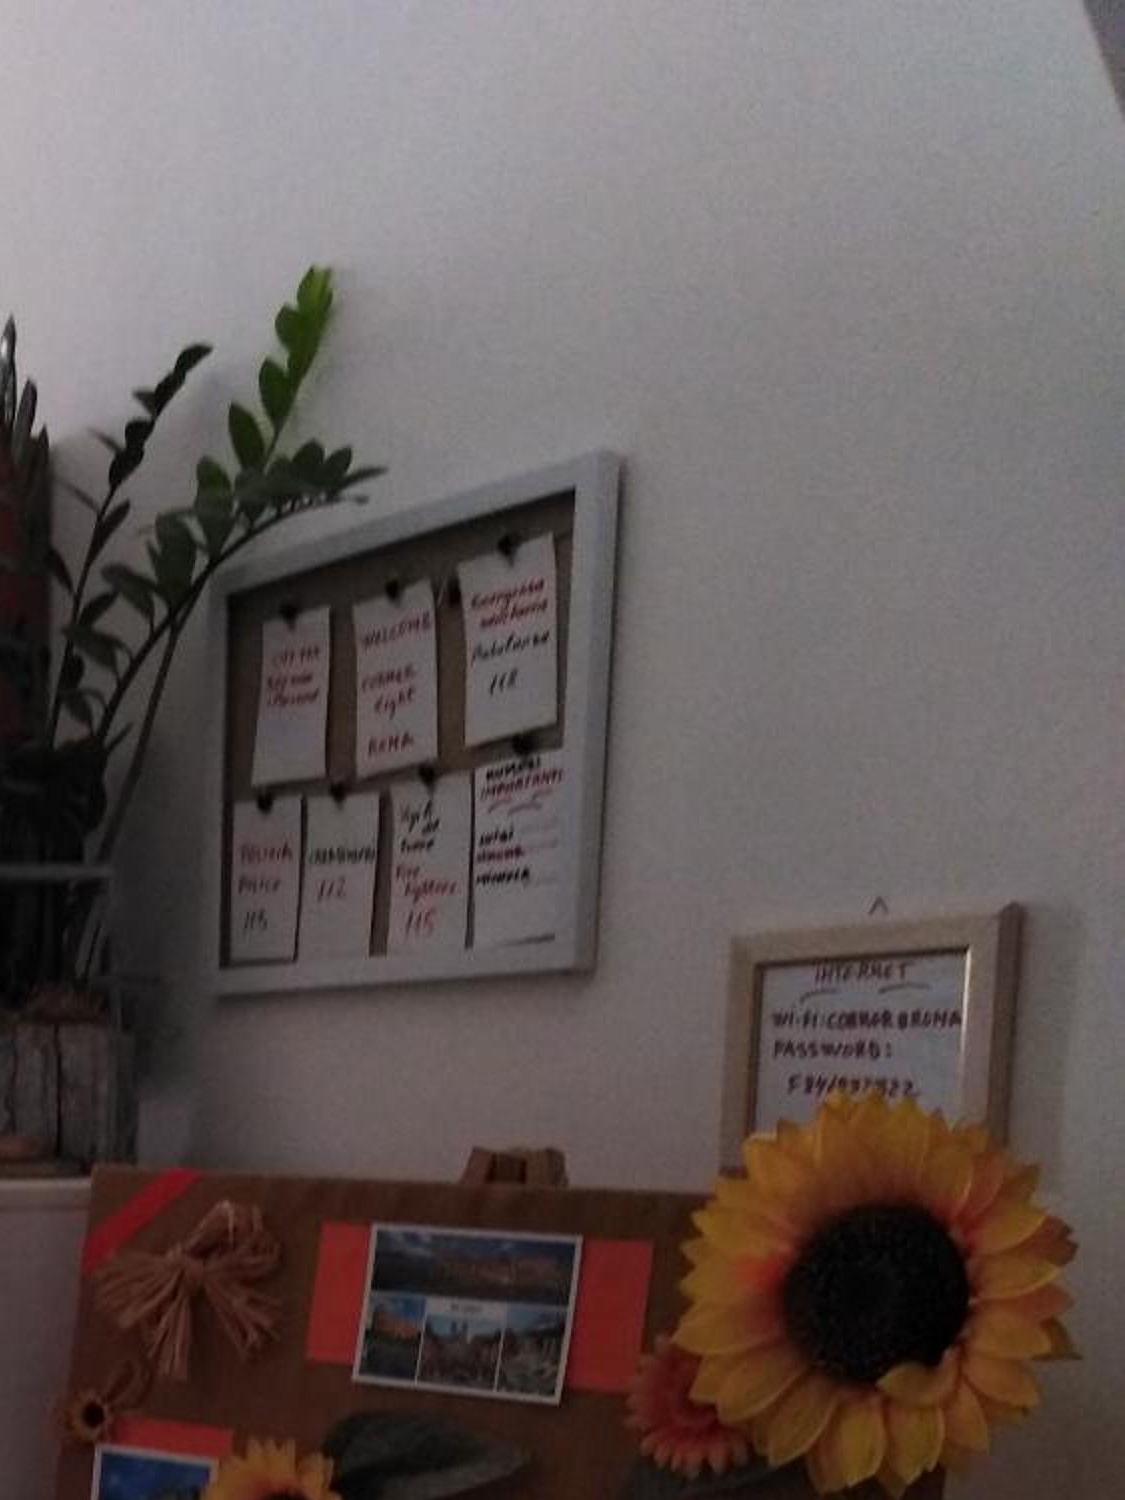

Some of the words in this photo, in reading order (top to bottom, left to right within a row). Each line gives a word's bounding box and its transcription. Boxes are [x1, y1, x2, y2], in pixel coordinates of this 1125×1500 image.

[363, 610, 431, 650] WELCOME
[317, 876, 346, 903] 112
[406, 908, 436, 938] 115
[815, 961, 912, 983] INTERNET
[773, 1041, 892, 1060] PASSWORD:
